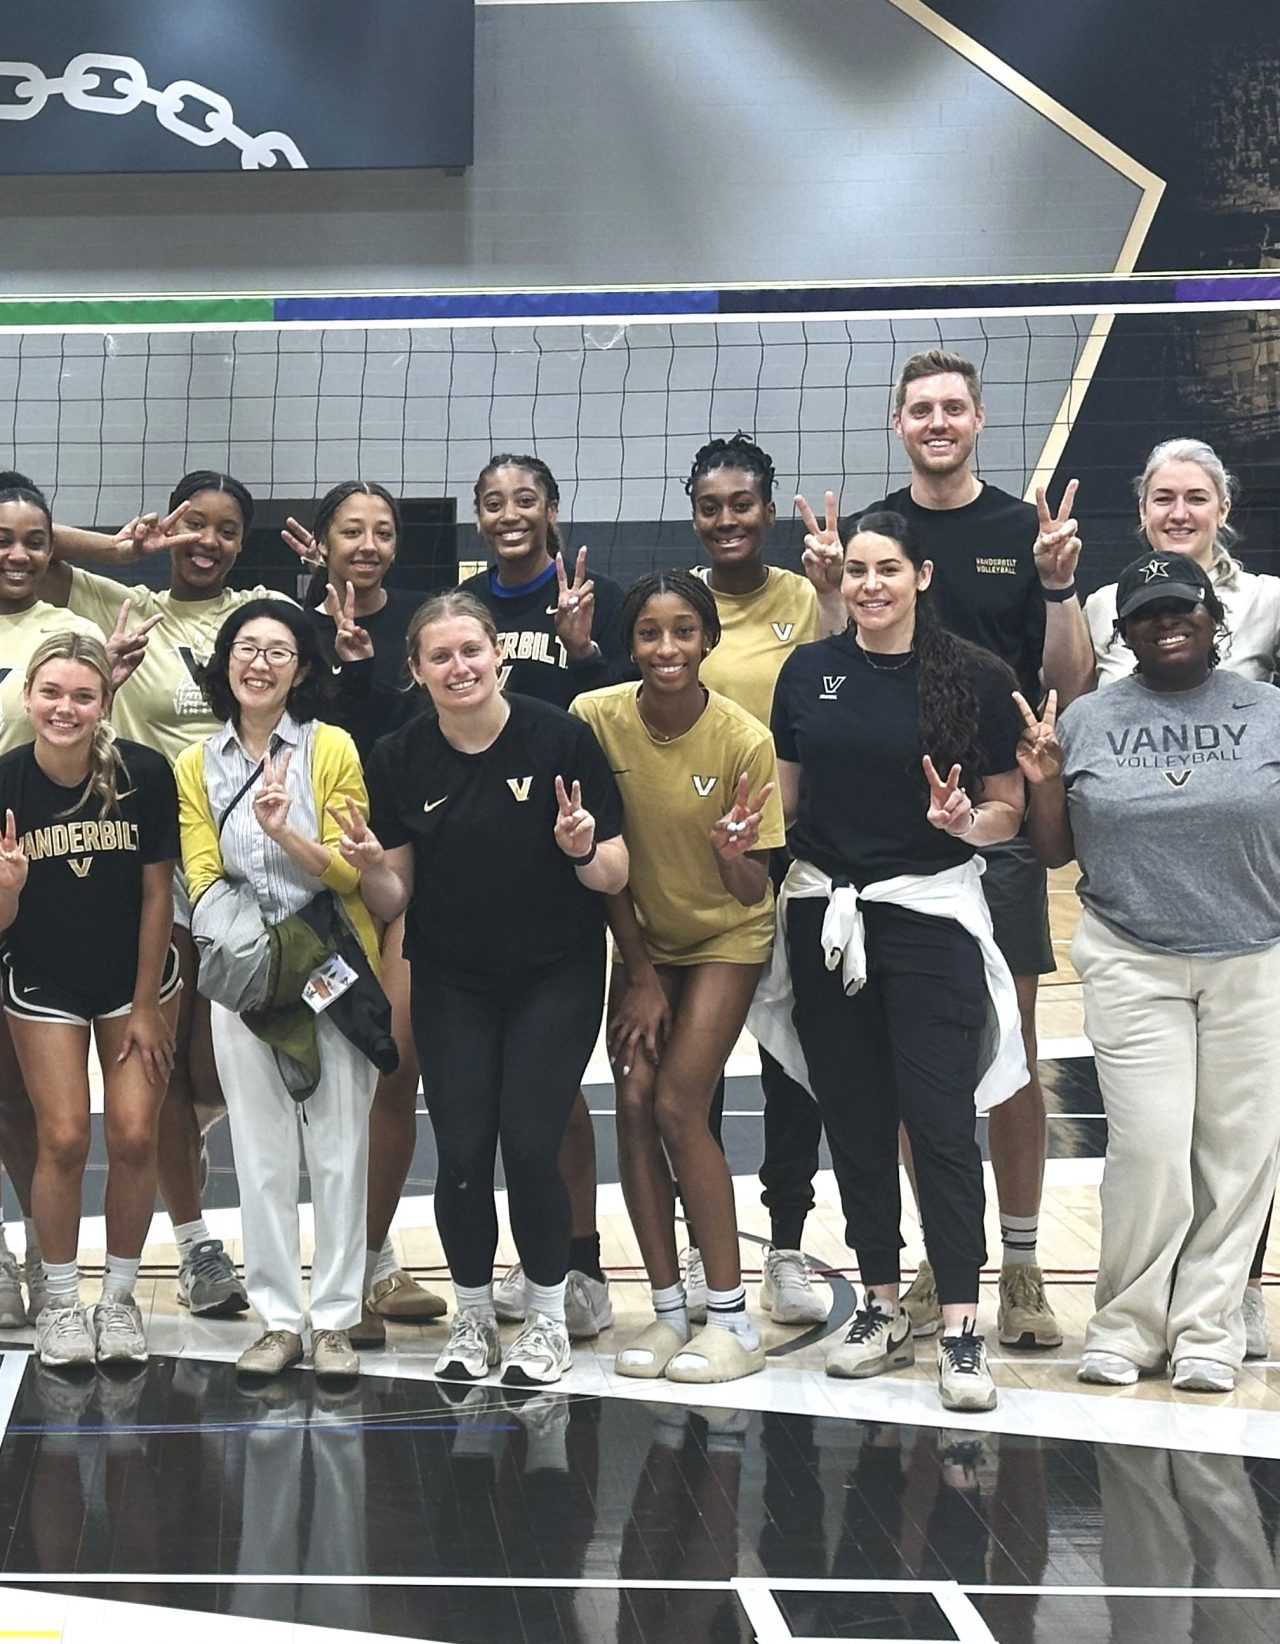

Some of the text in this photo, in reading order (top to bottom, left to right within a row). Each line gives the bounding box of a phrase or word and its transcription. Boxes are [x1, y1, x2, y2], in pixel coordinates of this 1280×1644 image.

[769, 621, 795, 642] V
[822, 675, 847, 693] V
[1106, 723, 1248, 756] VANDY
[1116, 748, 1244, 769] VOLLEYBALL
[506, 775, 534, 802] V
[691, 774, 719, 797] V
[1163, 770, 1193, 788] V
[67, 856, 94, 878] V
